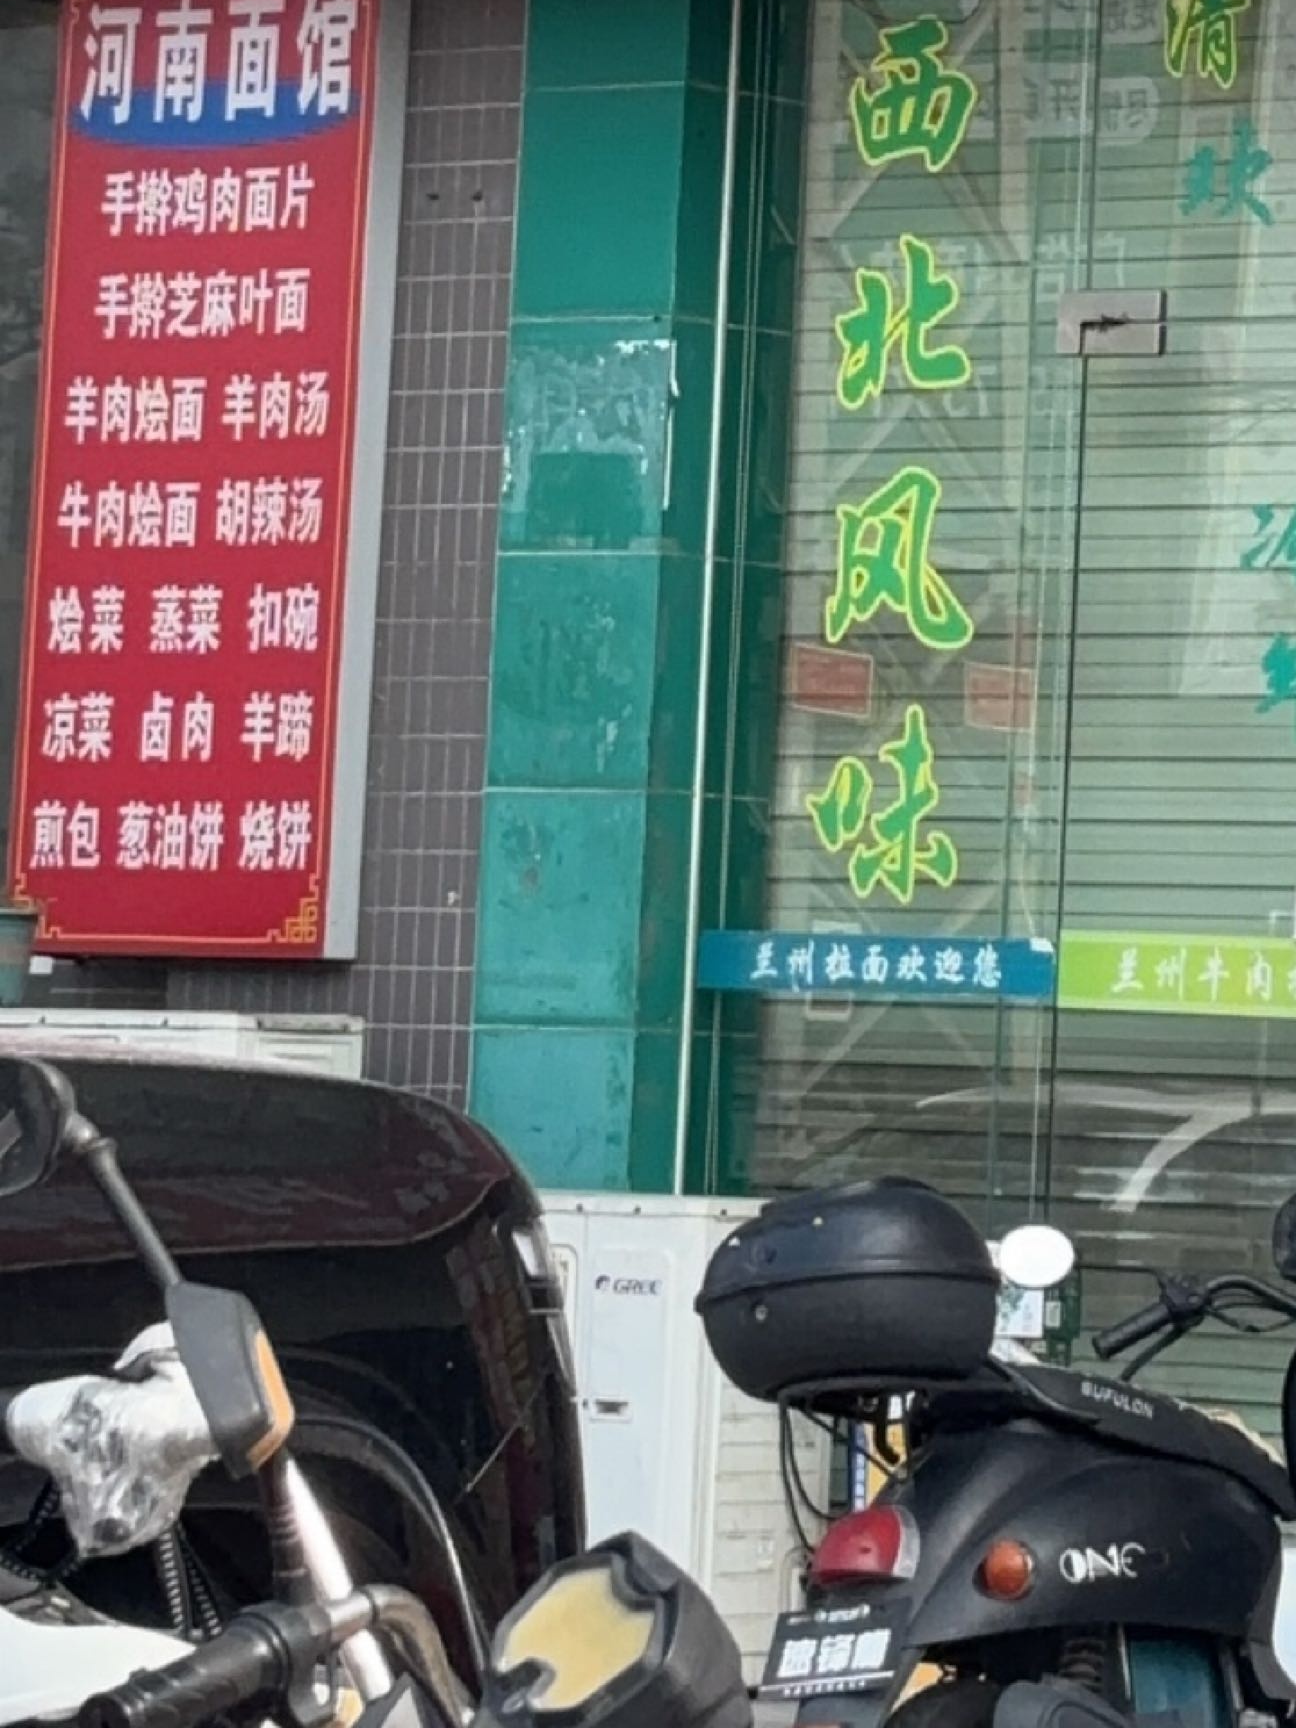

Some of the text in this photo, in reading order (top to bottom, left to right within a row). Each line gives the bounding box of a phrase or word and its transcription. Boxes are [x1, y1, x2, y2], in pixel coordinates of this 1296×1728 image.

[64, 371, 330, 444] 羊肉烩面 羊肉汤
[806, 14, 977, 904] 西北风味
[57, 476, 324, 548] 牛肉烩面 胡辣汤
[48, 582, 321, 654] 烩菜 蒸菜 扣碗
[41, 690, 315, 762] 凉菜 卤肉 羊蹄
[29, 800, 312, 871] 煎包 葱油饼 烧饼
